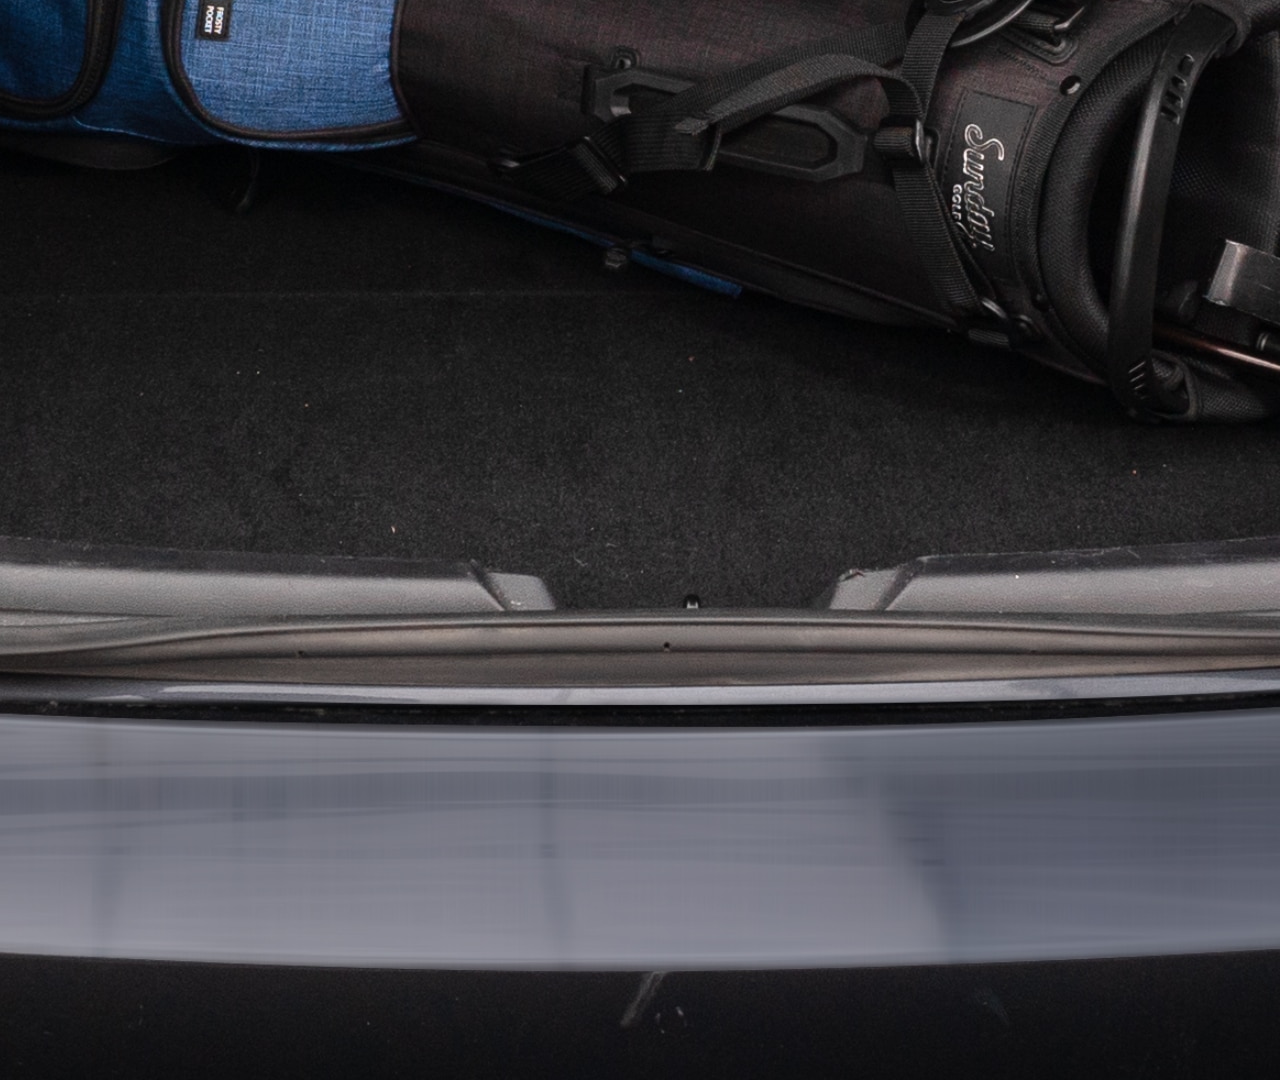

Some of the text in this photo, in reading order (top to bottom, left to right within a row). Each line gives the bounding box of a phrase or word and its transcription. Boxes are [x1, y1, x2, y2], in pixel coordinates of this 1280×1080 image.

[204, 5, 214, 33] POCKET
[214, 7, 224, 34] FROSTY
[951, 183, 963, 221] GOLF
[960, 123, 1004, 251] Sunday
